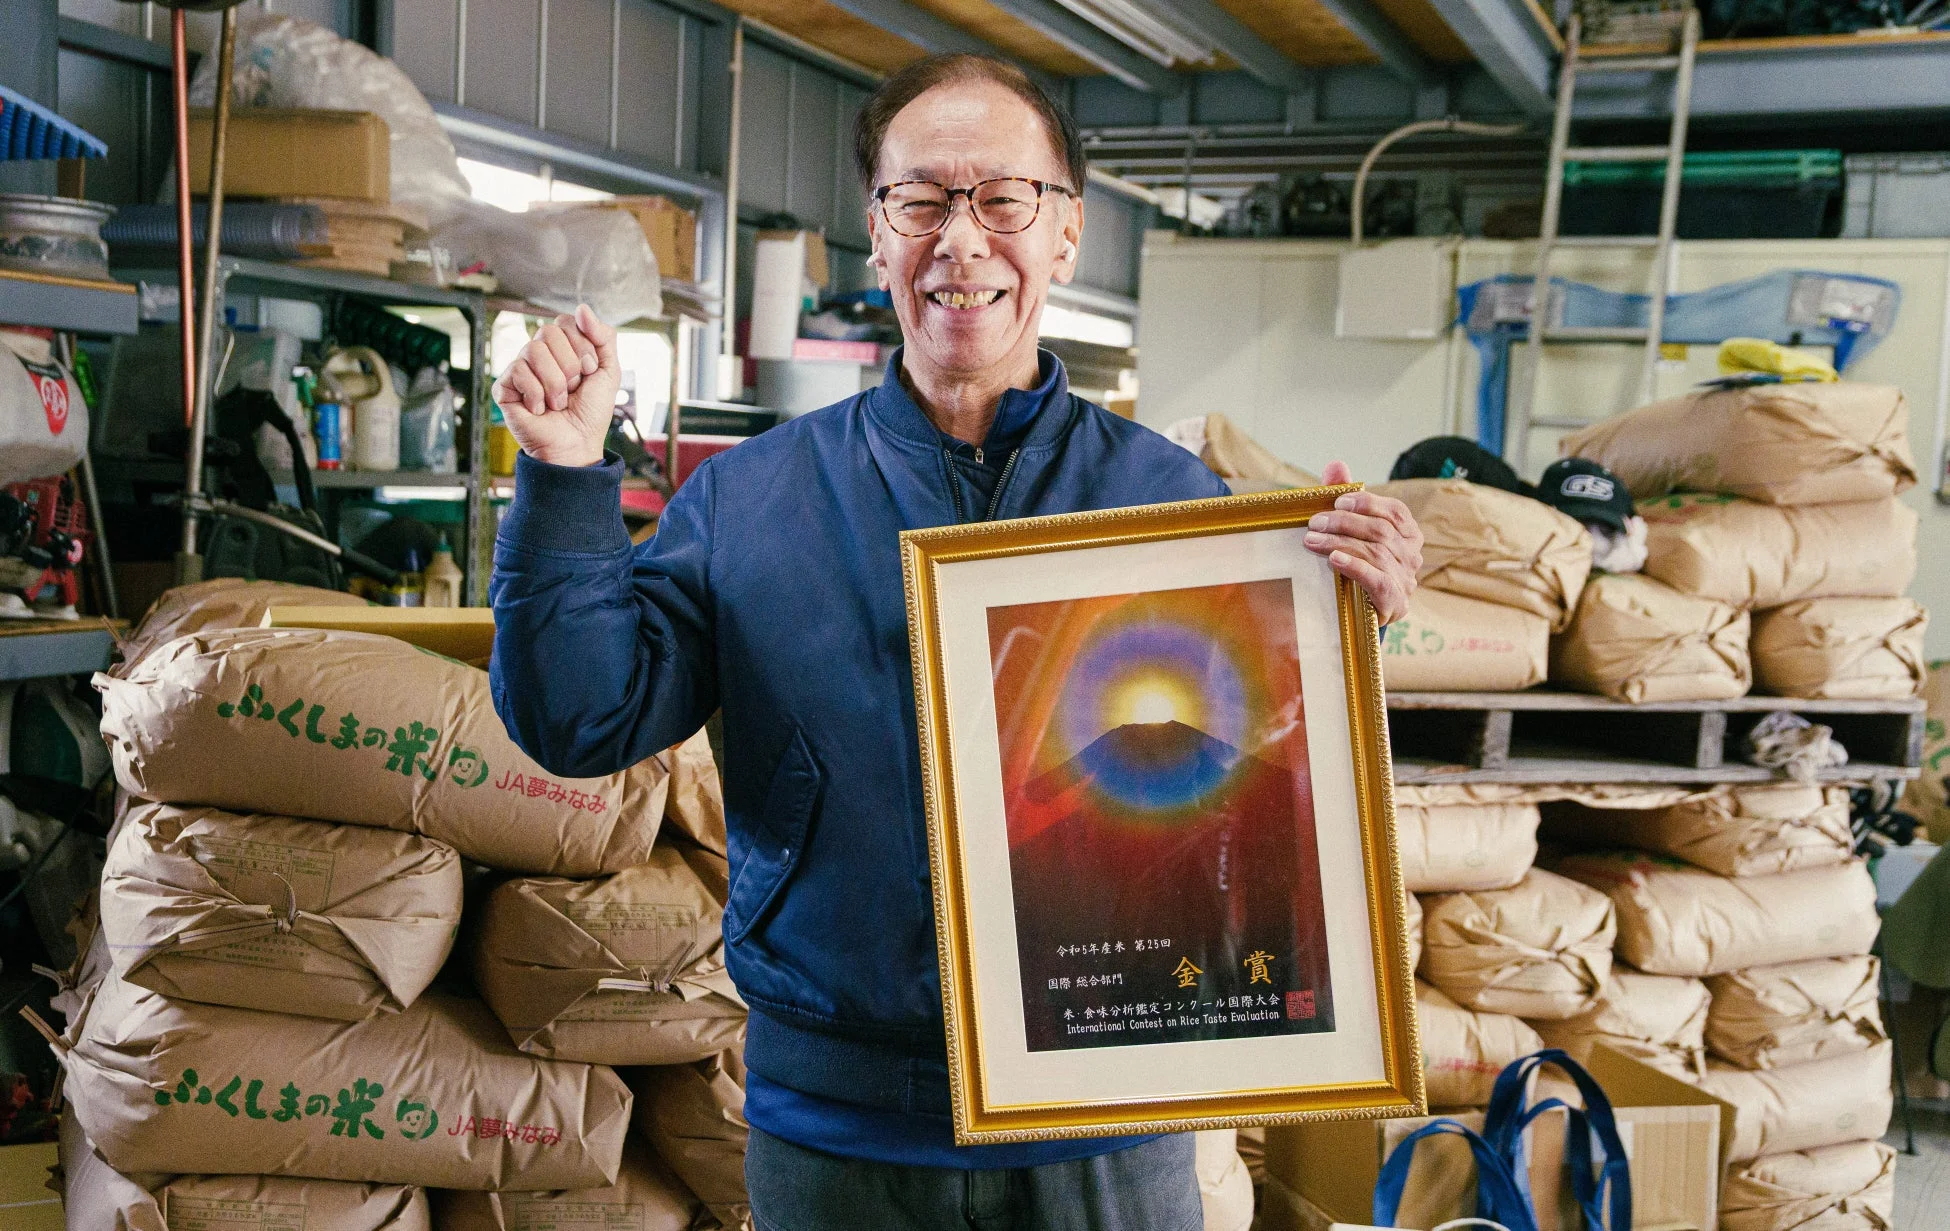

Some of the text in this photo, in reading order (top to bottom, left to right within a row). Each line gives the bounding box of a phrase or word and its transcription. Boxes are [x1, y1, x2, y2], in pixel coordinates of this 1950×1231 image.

[217, 683, 437, 781] ふくしまの米
[495, 769, 607, 814] JA夢みなみ
[1056, 938, 1171, 957] 令和5年産米 第25回
[1067, 1009, 1280, 1035] International Contest on Rice Taste Evaluation
[154, 1067, 386, 1141] ふくしまの米
[447, 1114, 562, 1147] JA夢みなみ
